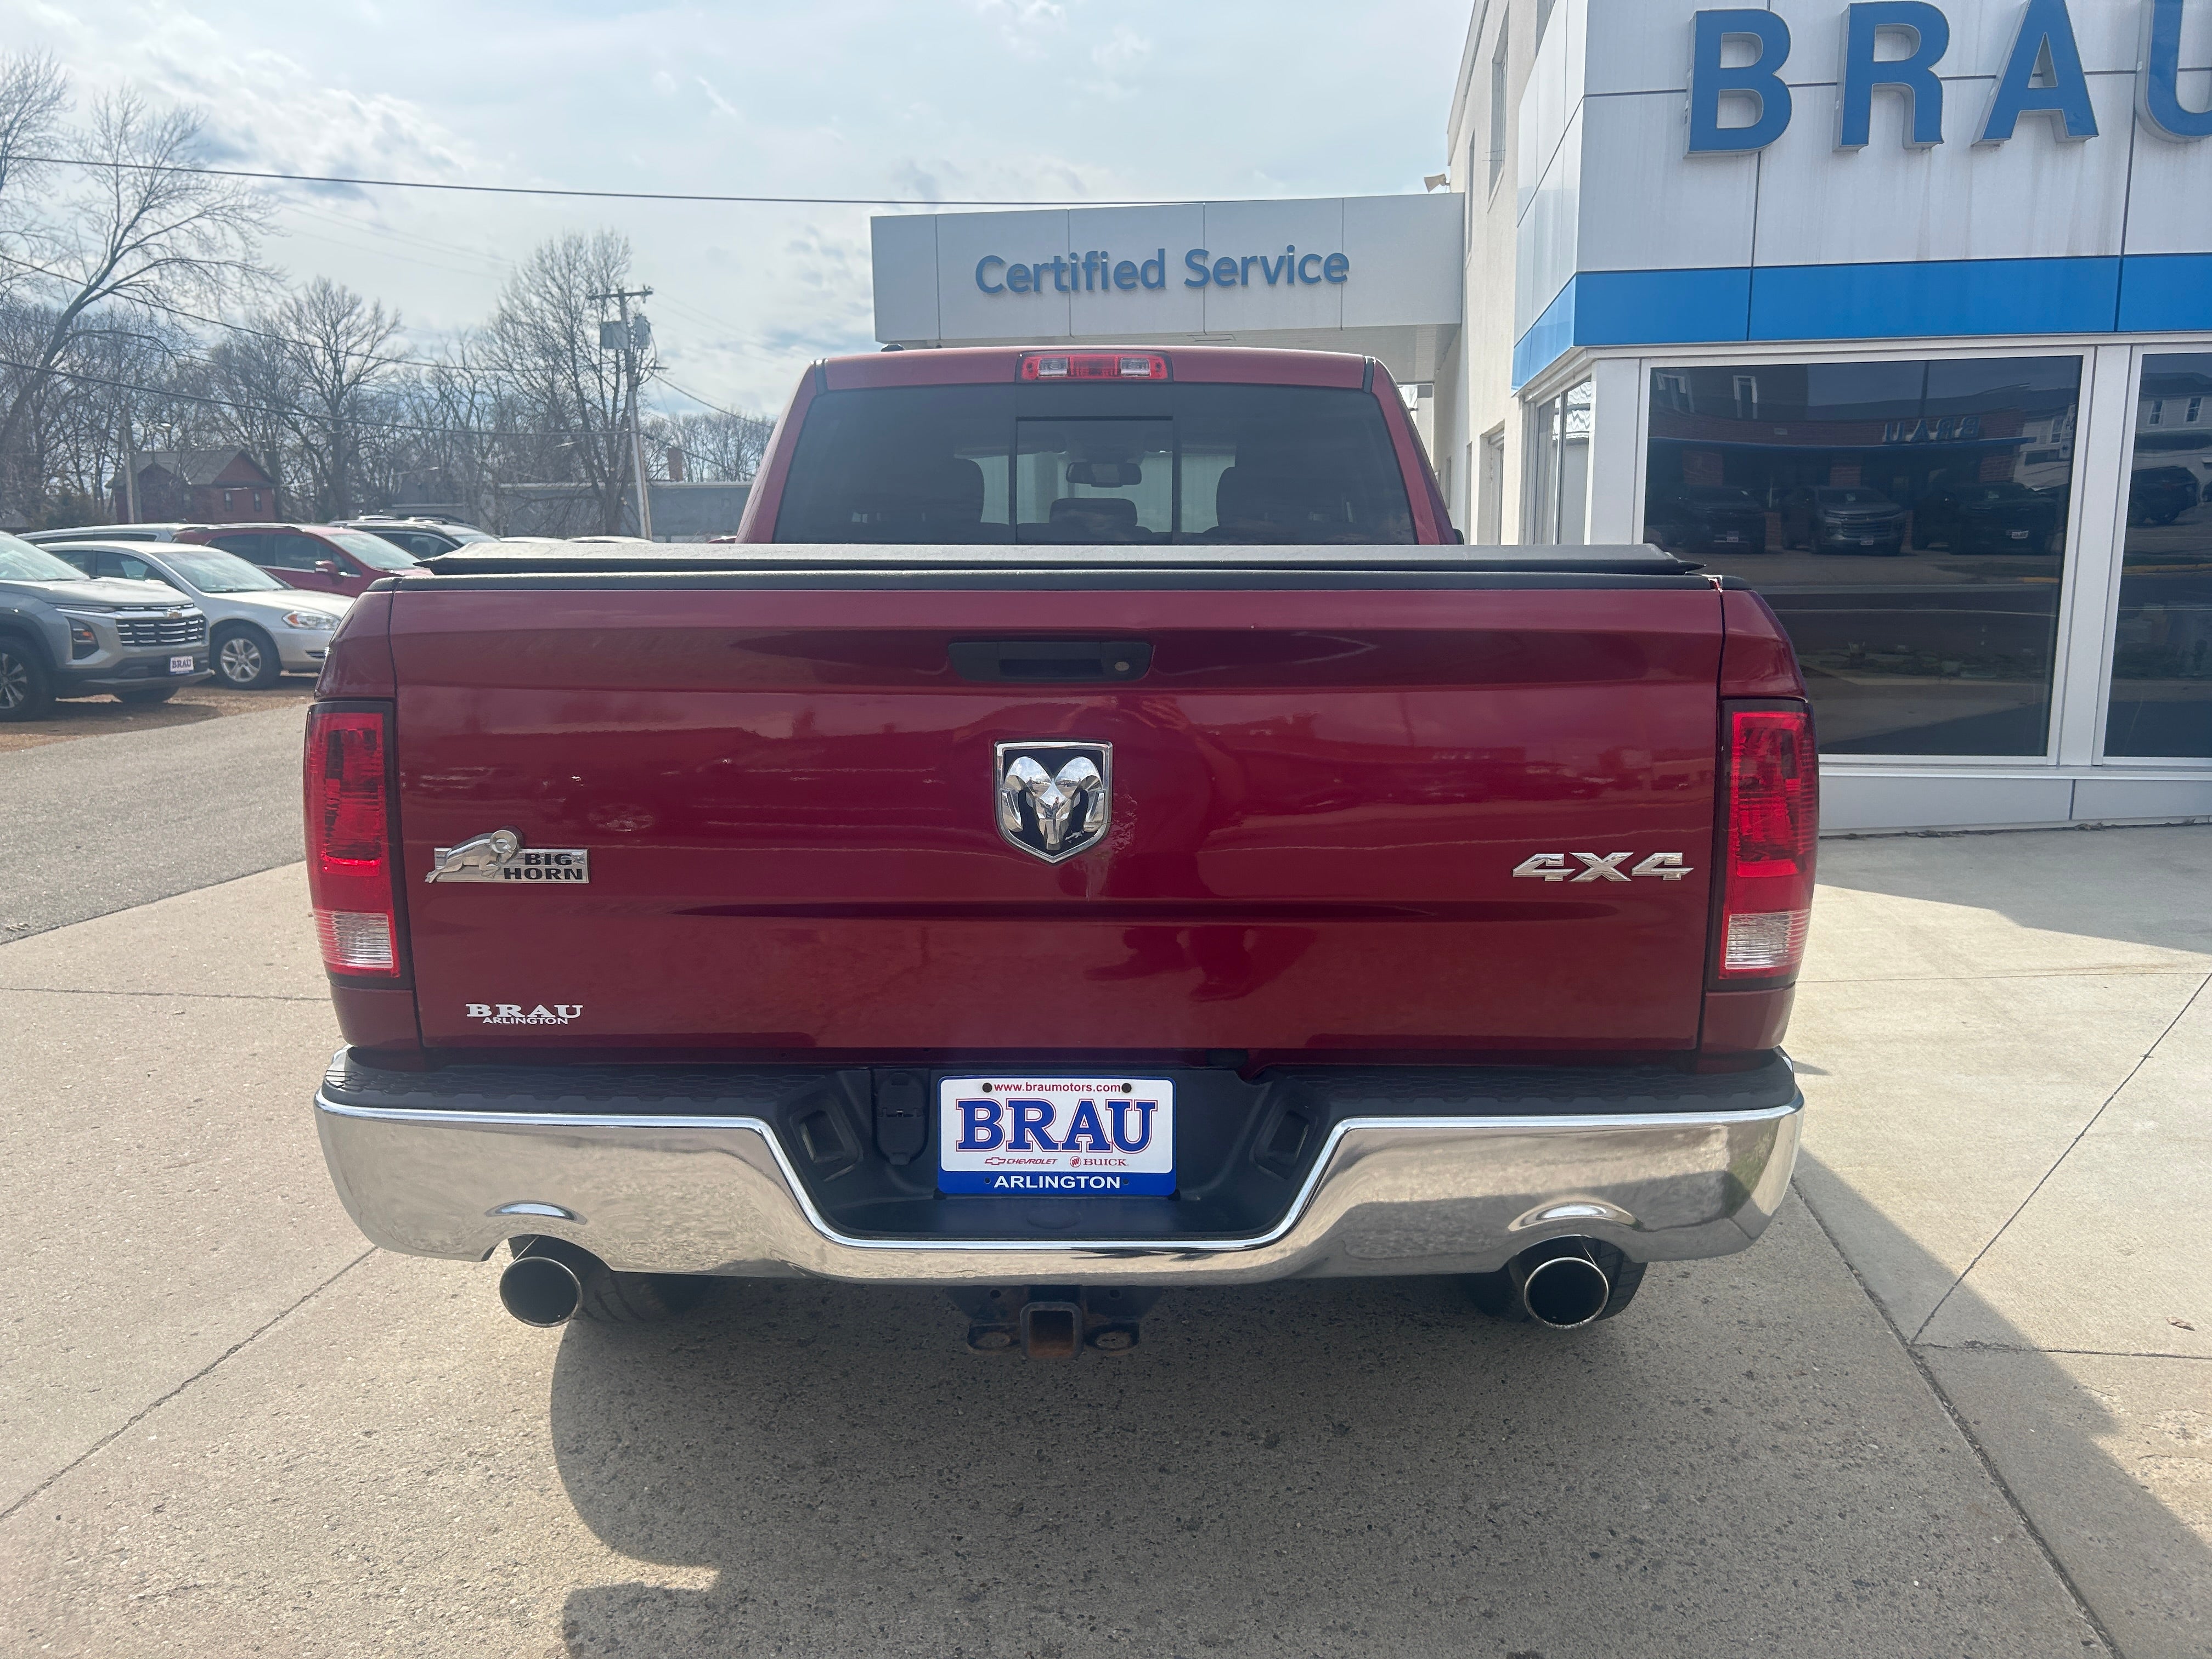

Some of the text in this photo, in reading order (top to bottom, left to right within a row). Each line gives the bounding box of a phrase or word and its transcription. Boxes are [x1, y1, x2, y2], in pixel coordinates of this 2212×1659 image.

[975, 244, 1350, 294] Certified Service
[172, 659, 191, 668] BRAU
[524, 853, 572, 866] BIG
[503, 867, 583, 880] HORN
[1513, 852, 1694, 882] 4X4
[465, 1003, 583, 1018] BRAU
[482, 1017, 568, 1025] ARLINGTON
[994, 1082, 1121, 1093] www.braumotors.com
[956, 1098, 1158, 1154] BRAU
[994, 1176, 1120, 1189] ARLINGTON
